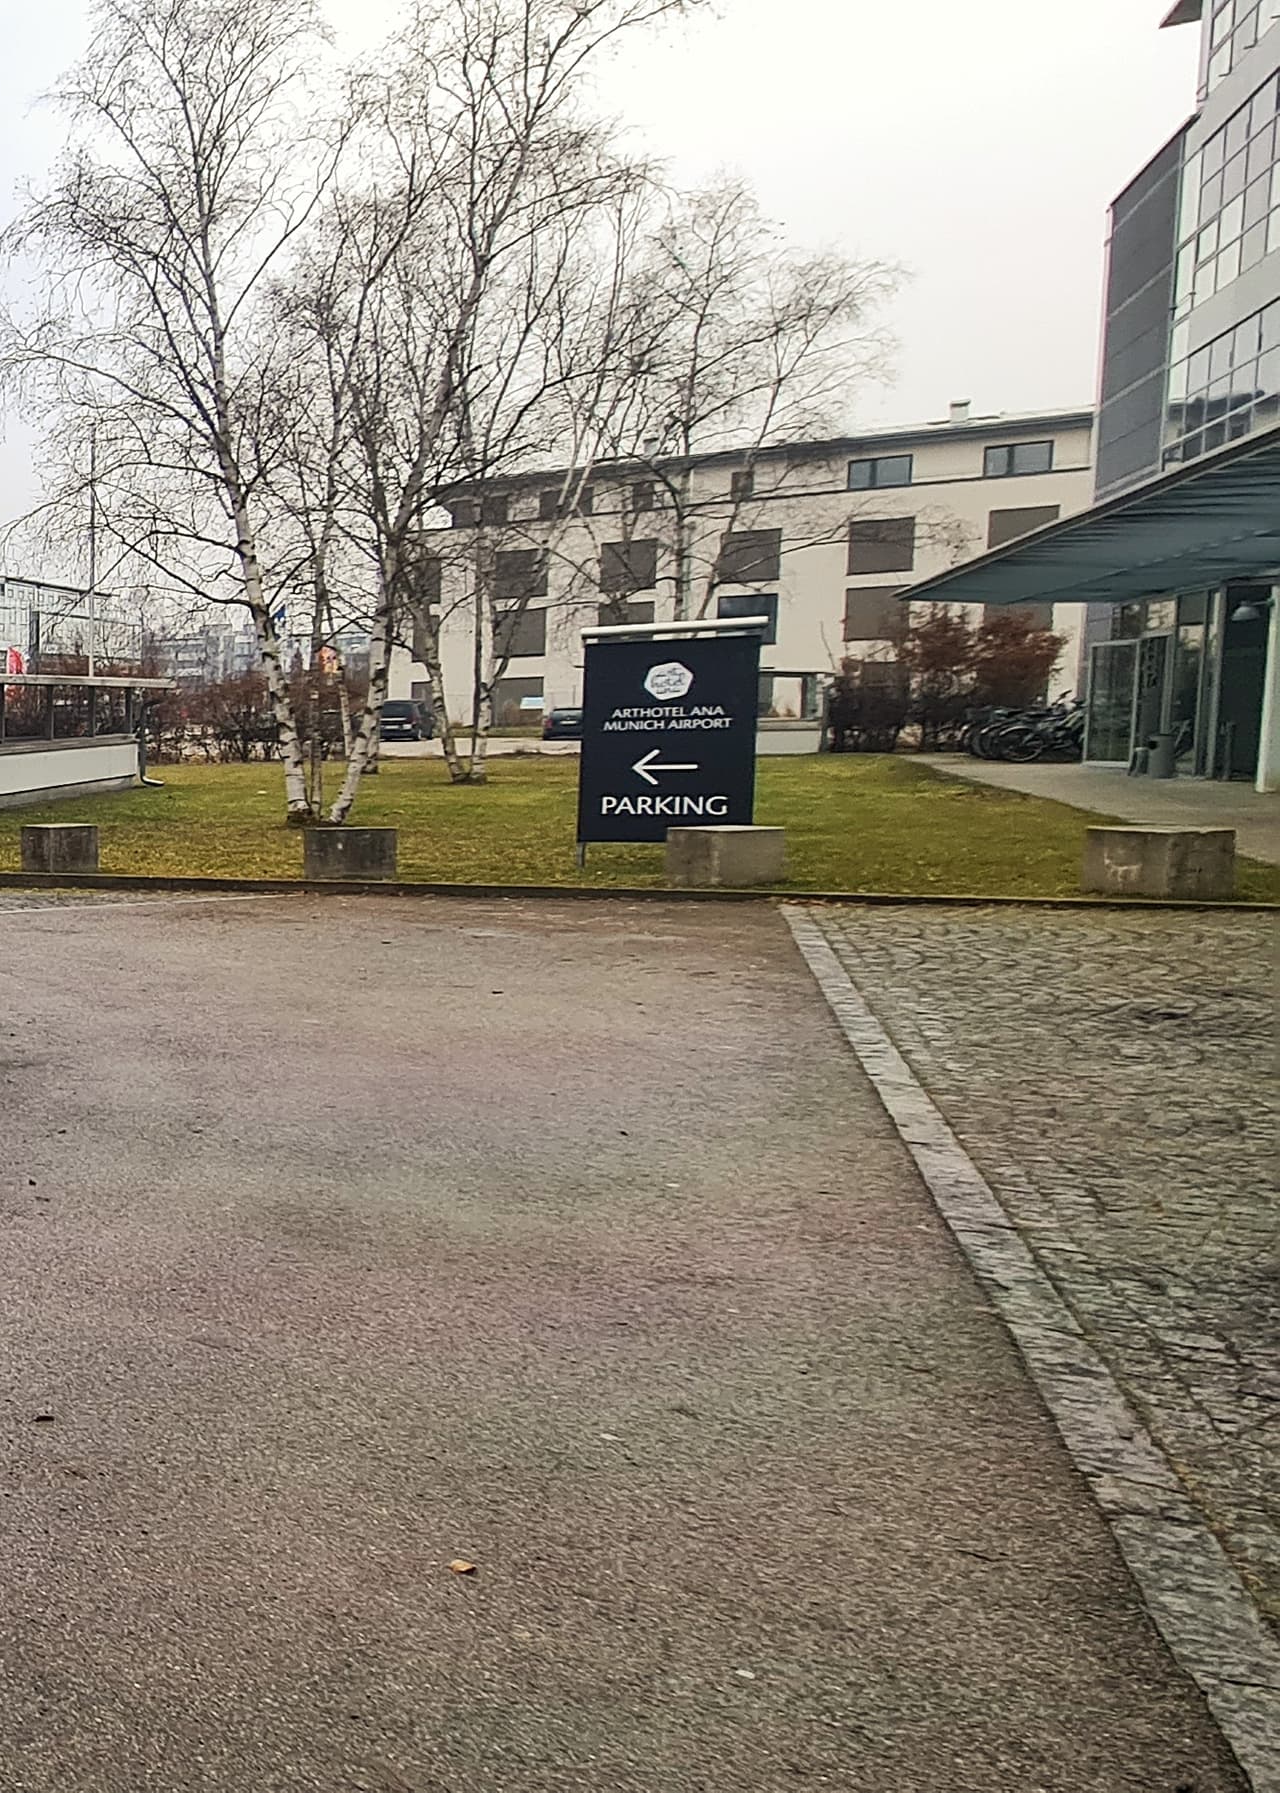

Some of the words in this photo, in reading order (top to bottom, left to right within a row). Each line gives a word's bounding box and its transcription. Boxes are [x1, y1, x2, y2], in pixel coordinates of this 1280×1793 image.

[612, 706, 688, 719] ARTHOTEL
[690, 705, 725, 716] ANA
[603, 719, 664, 731] MUNICH
[667, 717, 733, 730] AIRPORT
[601, 795, 729, 816] PARKING
